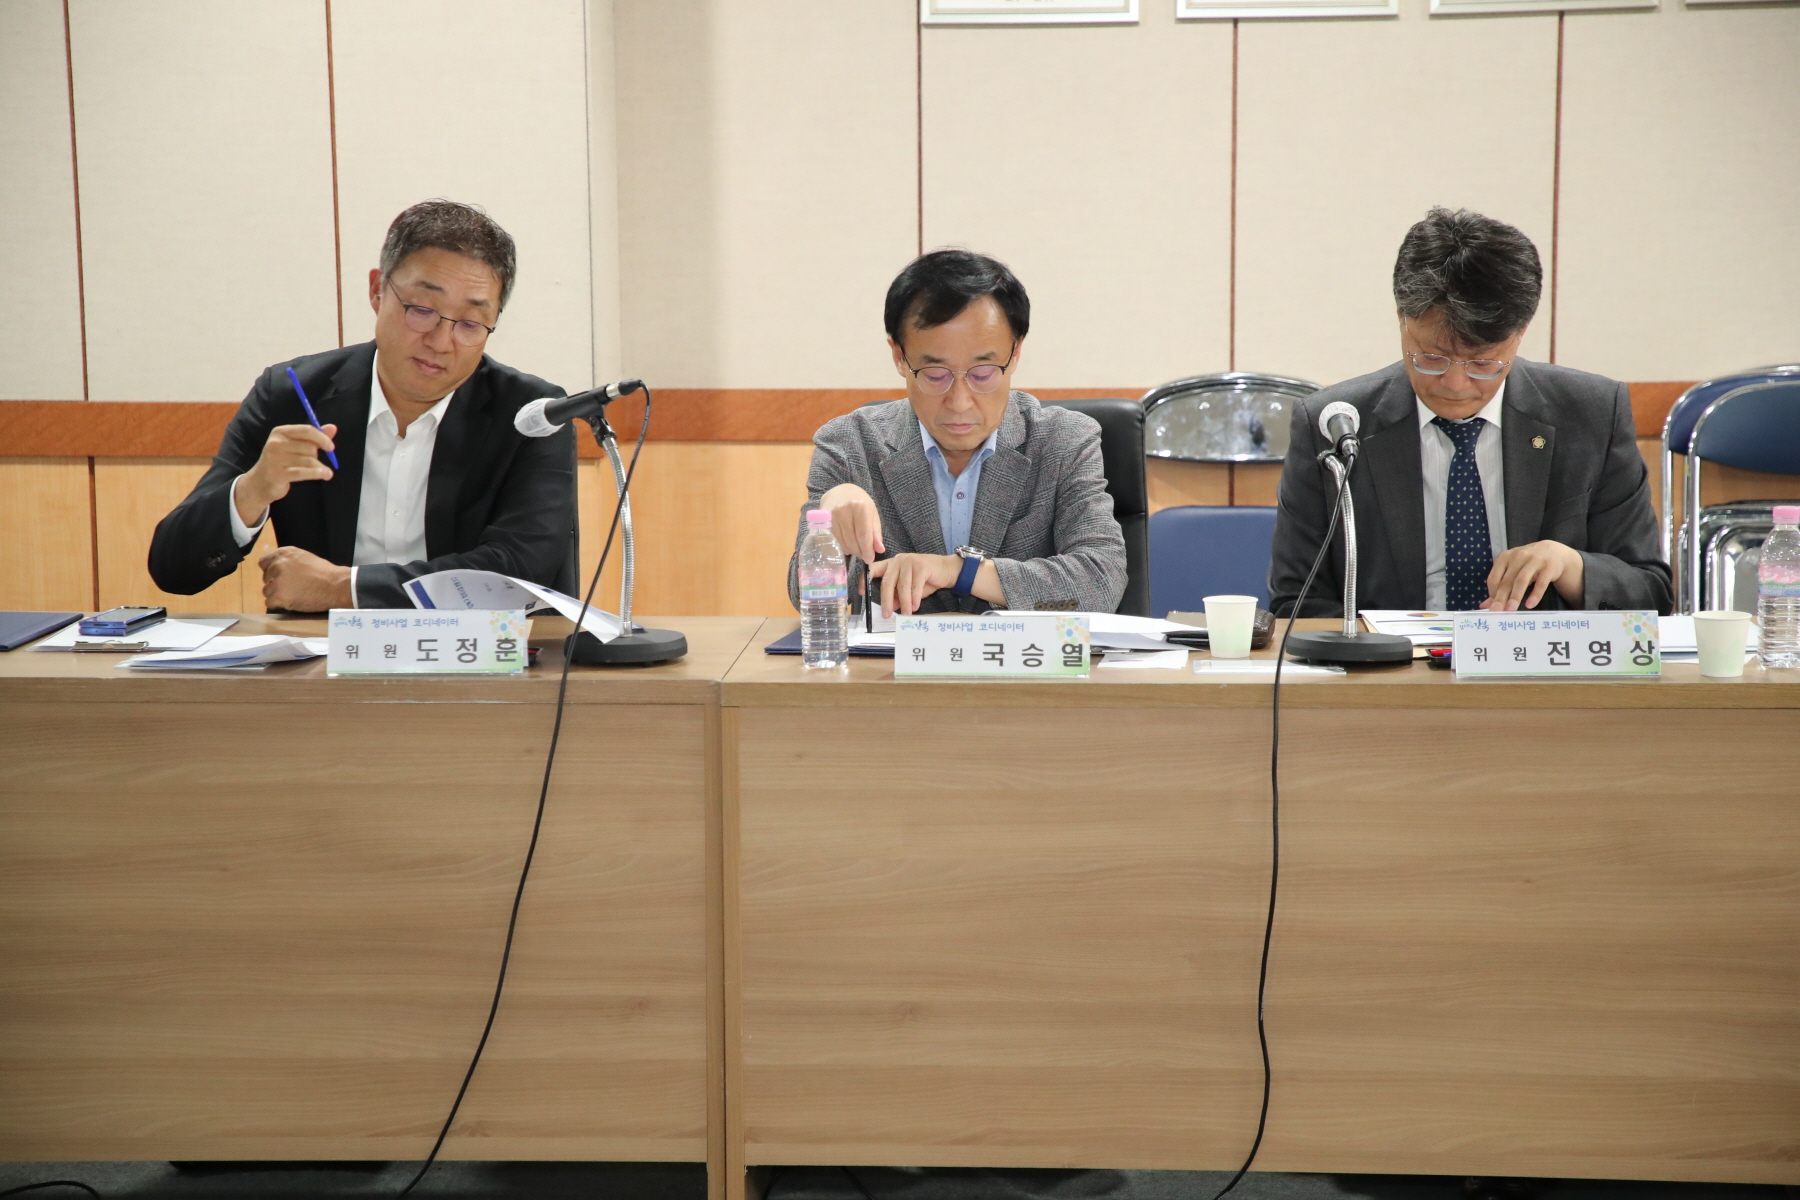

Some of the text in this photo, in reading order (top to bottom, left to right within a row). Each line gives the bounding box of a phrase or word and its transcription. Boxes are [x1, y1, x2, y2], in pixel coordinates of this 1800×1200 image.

[371, 618, 408, 628] 정비사업
[413, 617, 459, 628] 코디네이터
[937, 622, 974, 632] 정비사업
[978, 622, 1025, 632] 코디네이터
[1498, 620, 1536, 631] 정비사업
[1542, 619, 1590, 630] 코디네이터
[416, 637, 518, 663] 도정훈
[982, 643, 1083, 668] 국승열
[1547, 640, 1656, 667] 전영상
